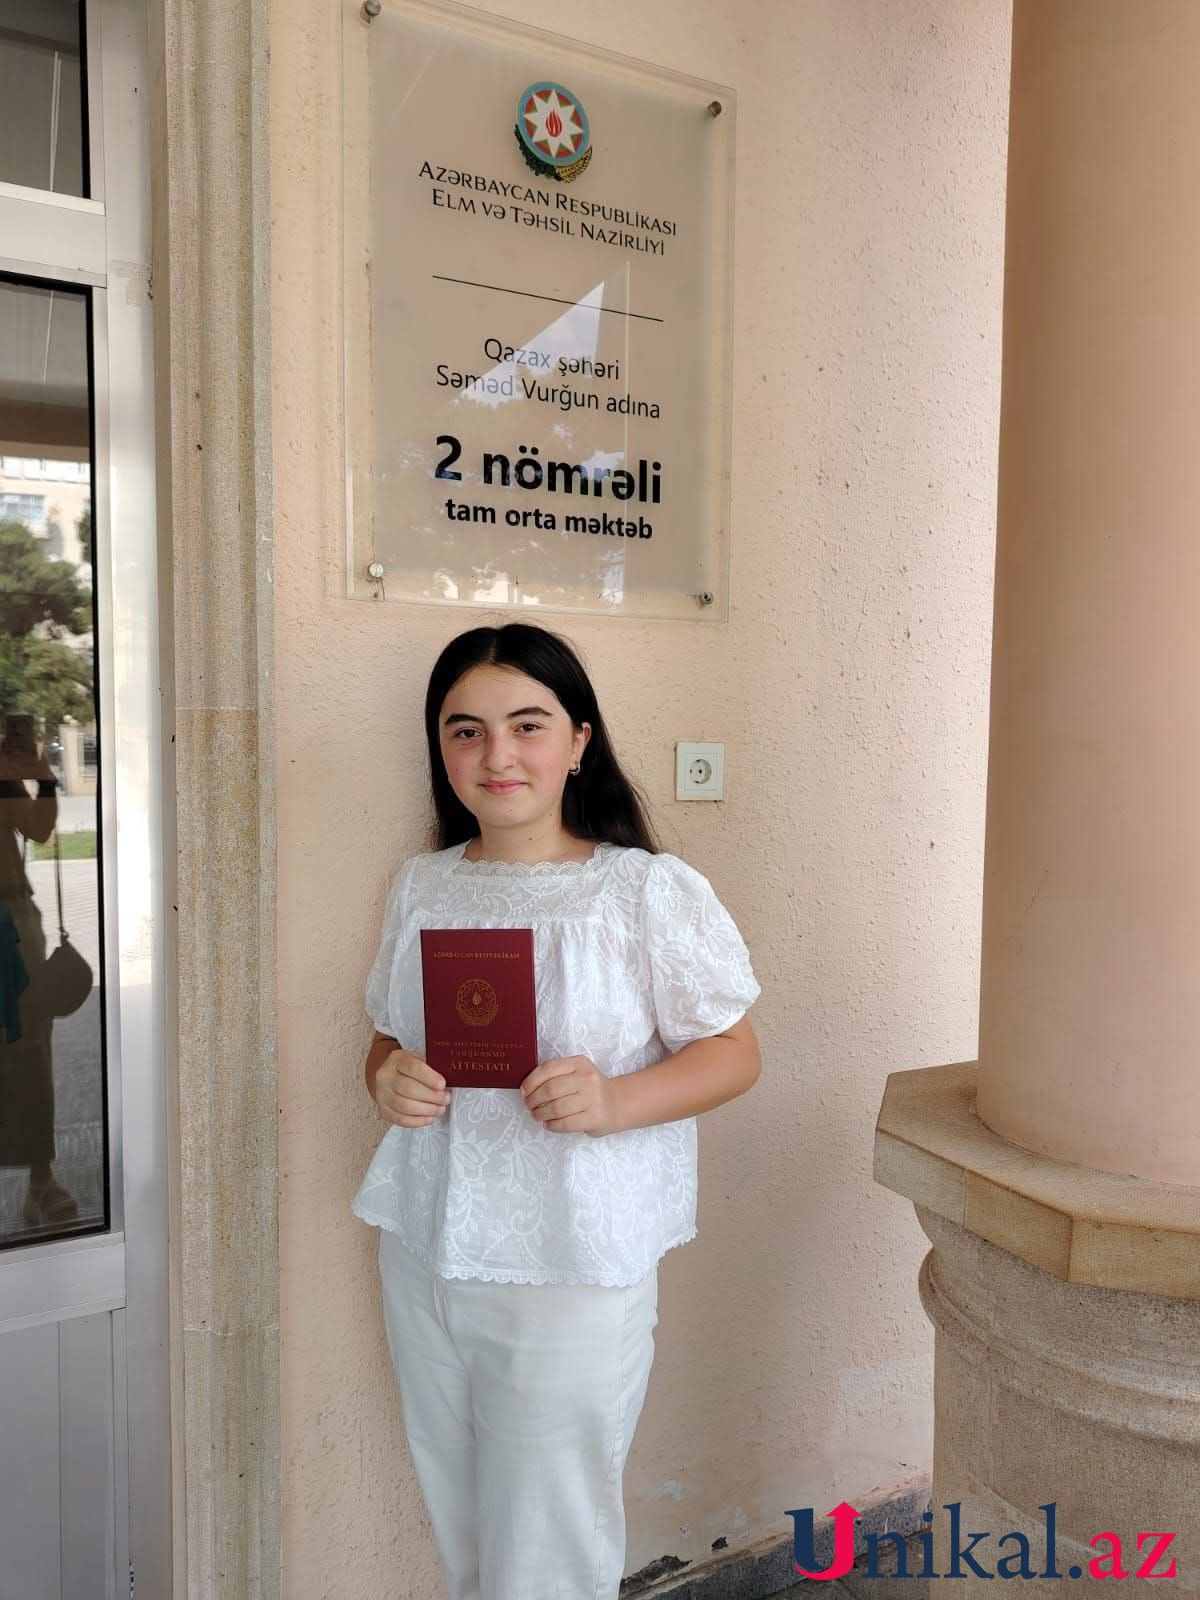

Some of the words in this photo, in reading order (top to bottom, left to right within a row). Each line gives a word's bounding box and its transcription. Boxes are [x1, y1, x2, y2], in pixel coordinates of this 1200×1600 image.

[418, 160, 550, 207] AZƏRBAYCAN
[555, 191, 676, 236] RESPUBLİKASI
[432, 188, 476, 215] ELM
[482, 201, 506, 220] VƏ
[510, 206, 576, 236] TƏHSİL
[581, 221, 664, 257] NAZİRLİYİ
[484, 338, 550, 369] Qazax
[558, 355, 620, 381] şəhəri
[436, 364, 514, 397] Səməd
[521, 377, 599, 411] Vurğun
[606, 393, 660, 419] adına
[434, 435, 462, 481] 2
[483, 445, 661, 504] nömrəli
[445, 499, 496, 524] tam
[505, 507, 556, 531] orta
[565, 513, 653, 540] məktəb
